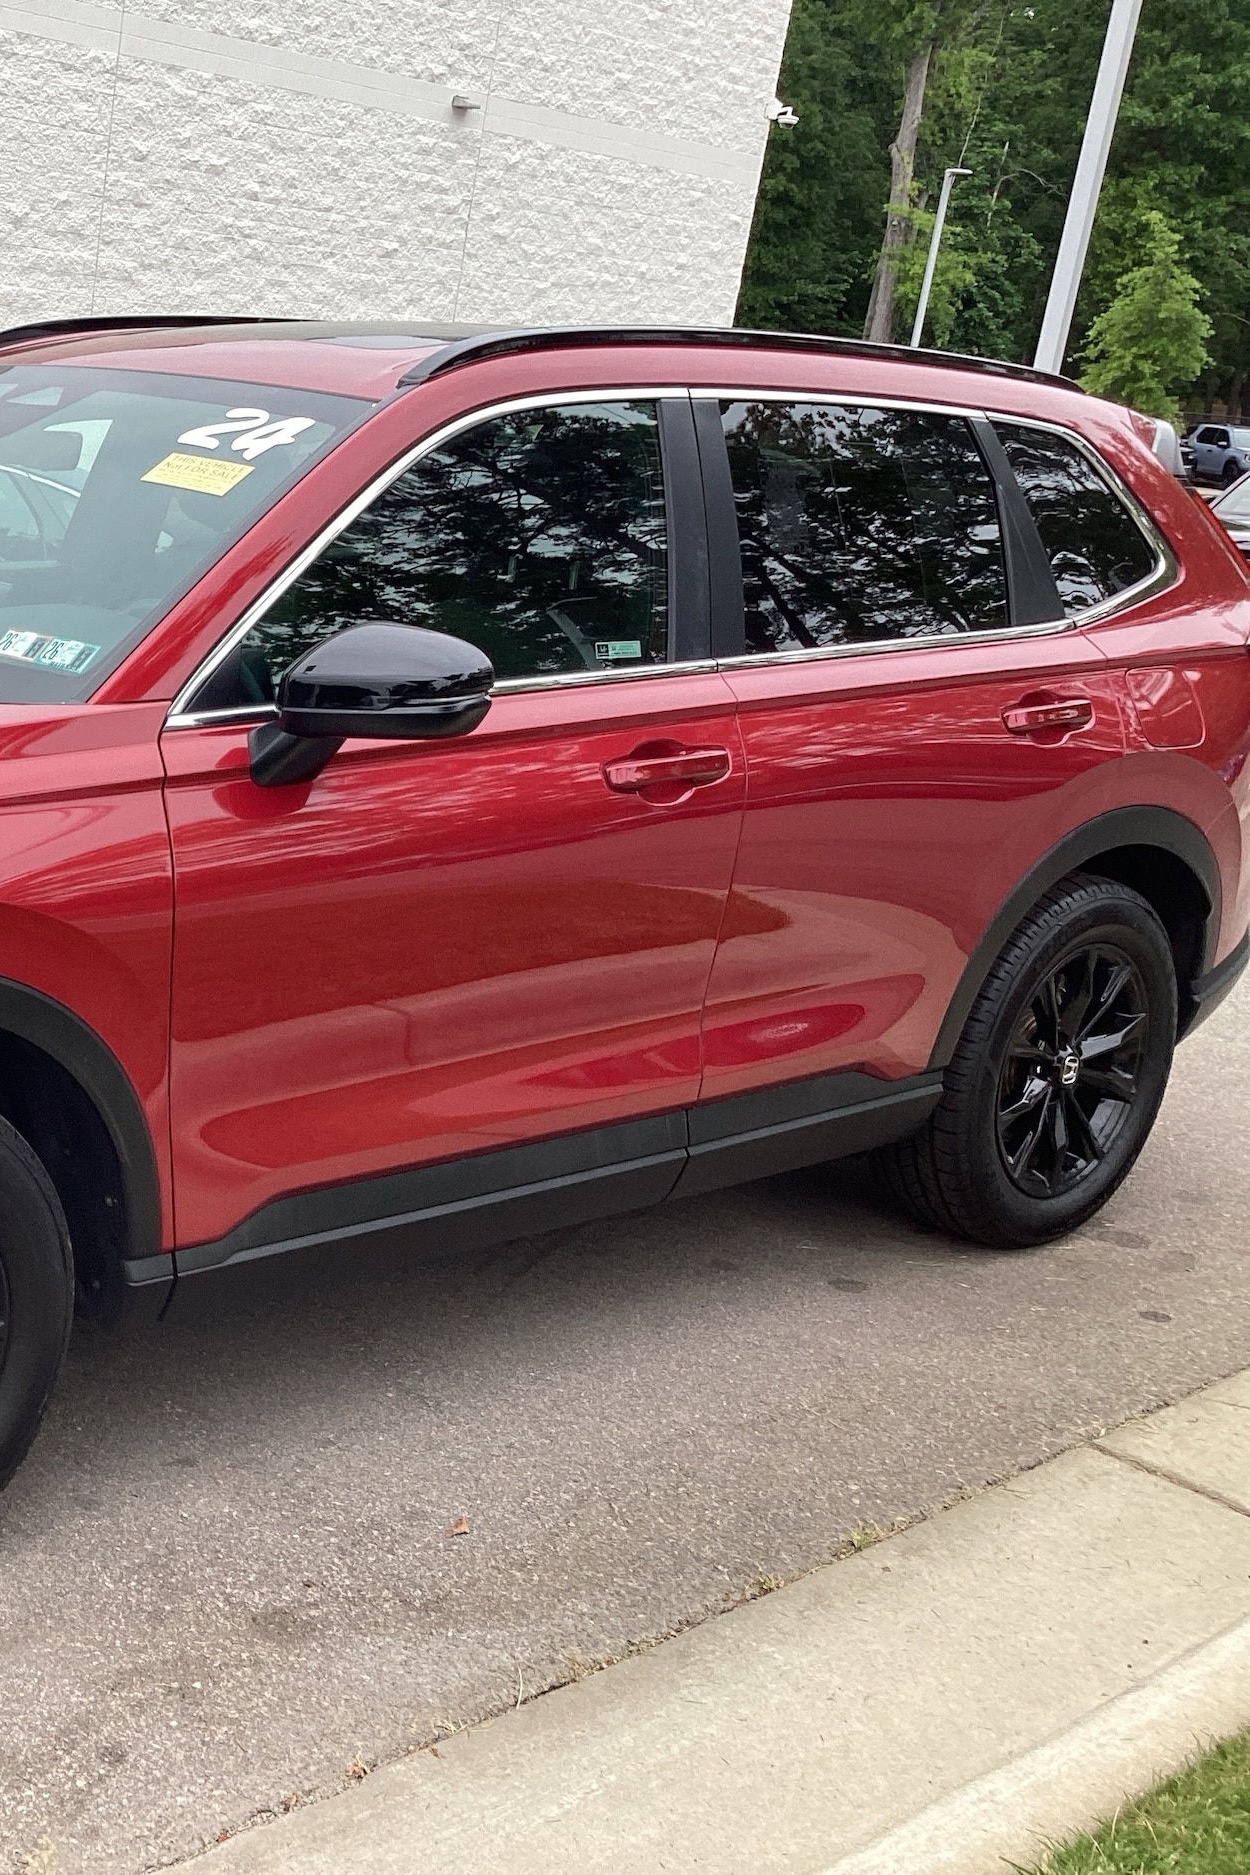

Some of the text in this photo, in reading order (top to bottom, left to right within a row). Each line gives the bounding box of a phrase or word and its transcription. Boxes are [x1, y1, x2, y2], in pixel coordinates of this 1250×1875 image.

[177, 407, 316, 461] 24
[172, 455, 247, 474] THIS VEHICLE
[184, 463, 209, 475] FOR
[209, 469, 241, 480] SALE
[41, 641, 65, 660] 26
